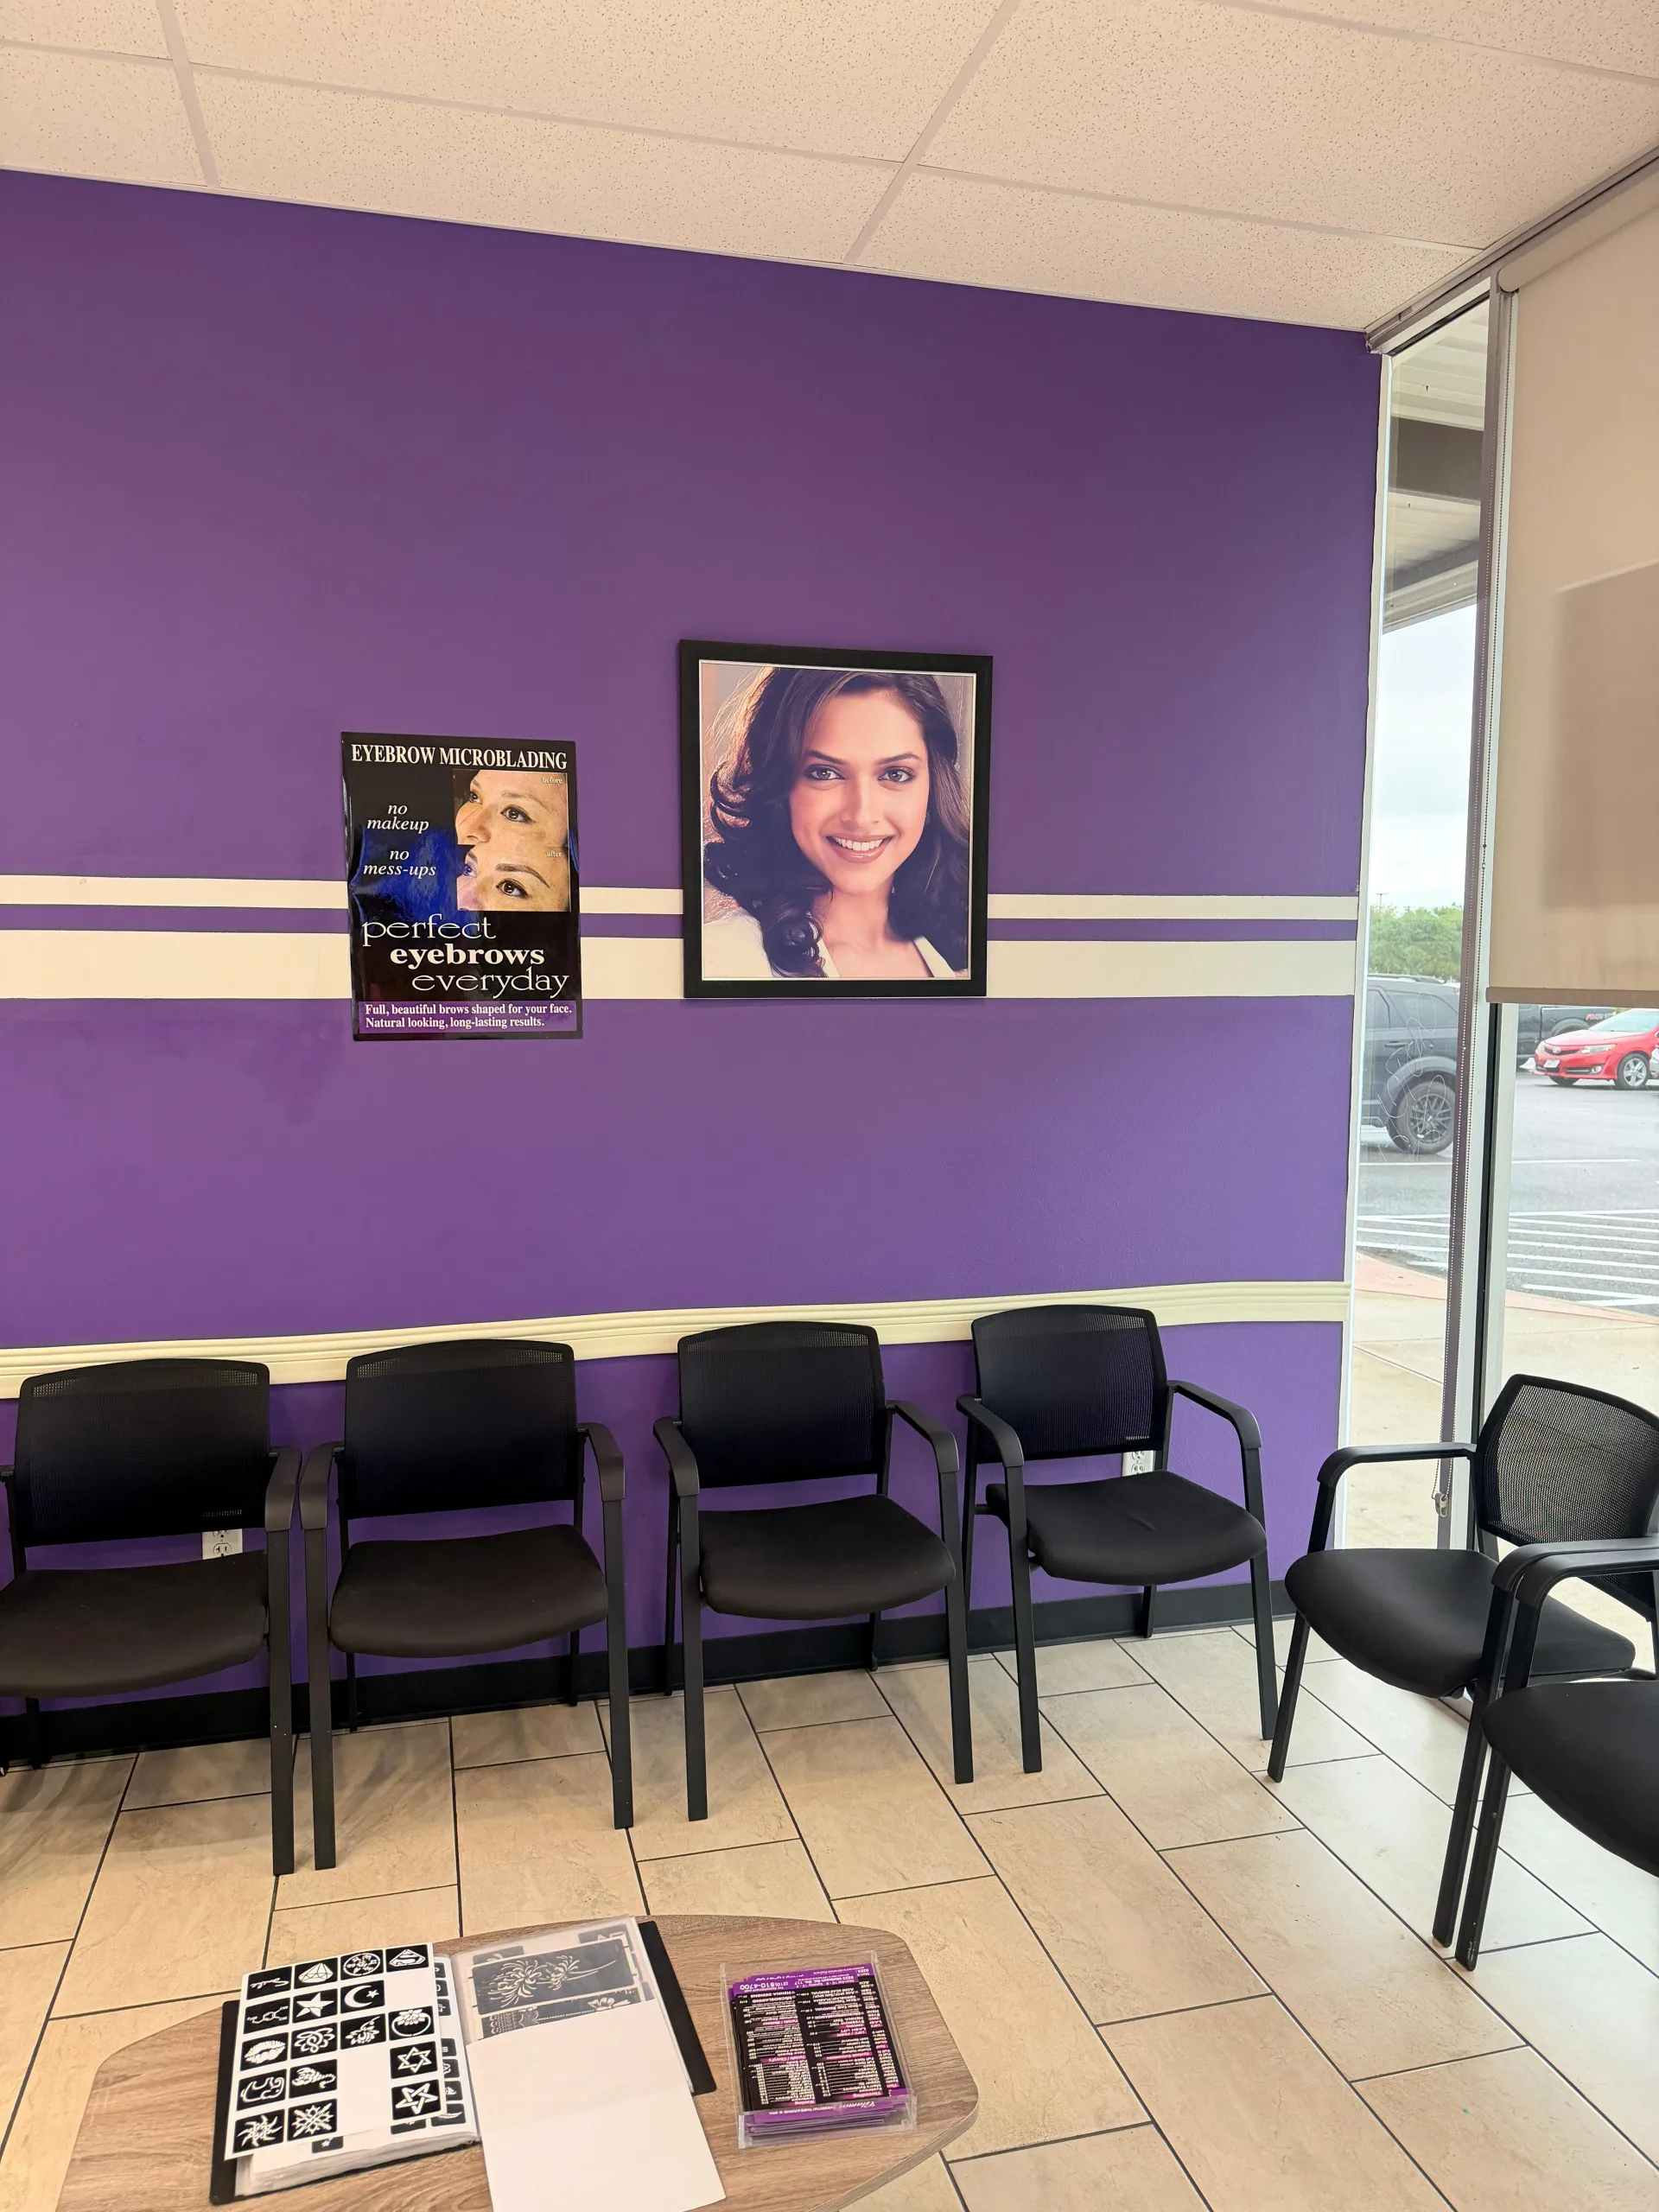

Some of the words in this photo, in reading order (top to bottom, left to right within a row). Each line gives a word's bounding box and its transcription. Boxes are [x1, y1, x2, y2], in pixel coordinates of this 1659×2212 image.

[351, 744, 435, 765] EYEBROW
[439, 747, 568, 769] MICROBLADING
[542, 776, 563, 785] before
[388, 804, 408, 816] no
[367, 817, 429, 835] makeup
[389, 849, 410, 861] no
[363, 863, 436, 880] mess-ups
[361, 913, 497, 947] perfect
[390, 943, 545, 969] eyebrows
[411, 966, 570, 1000] everyday
[365, 1004, 390, 1016] Full,
[391, 1003, 436, 1015] beautiful
[439, 1003, 469, 1014] brows
[471, 1003, 505, 1017] shaped
[508, 1002, 524, 1014] for
[525, 1005, 548, 1017] your
[550, 1002, 573, 1014] face.
[365, 1017, 405, 1028] Natural
[408, 1016, 448, 1030] looking,
[450, 1016, 507, 1030] long-lasting
[510, 1016, 545, 1027] results.
